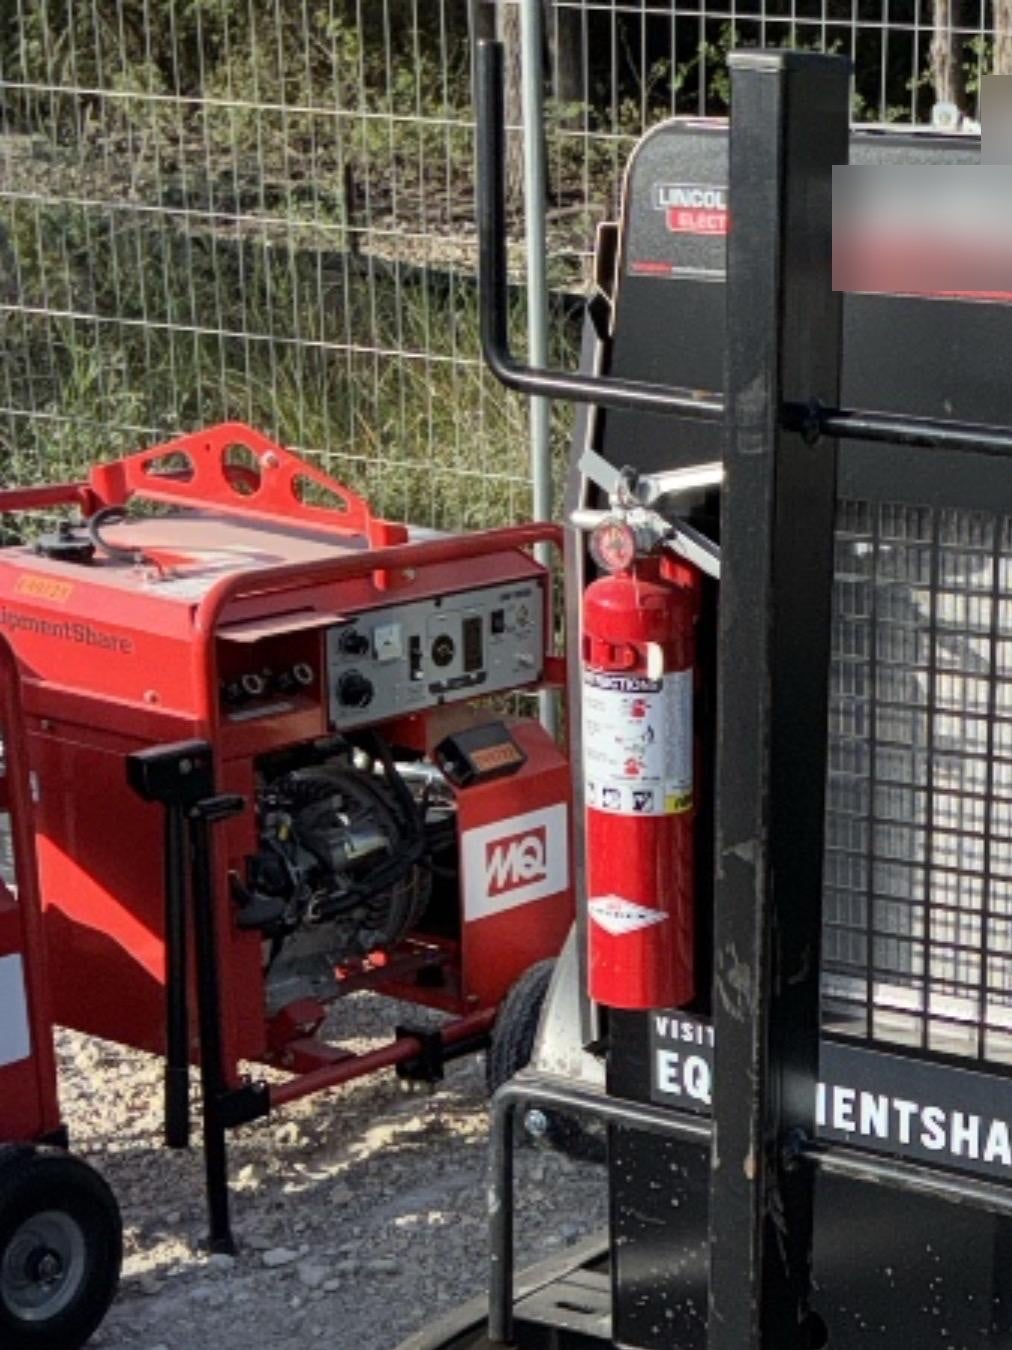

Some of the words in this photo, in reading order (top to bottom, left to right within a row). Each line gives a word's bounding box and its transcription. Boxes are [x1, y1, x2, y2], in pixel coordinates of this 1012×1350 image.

[659, 188, 728, 210] LINCOL
[677, 210, 728, 230] ELECT
[0, 605, 134, 655] ipmentShare
[486, 834, 547, 890] MQ
[656, 1015, 715, 1048] VISIT
